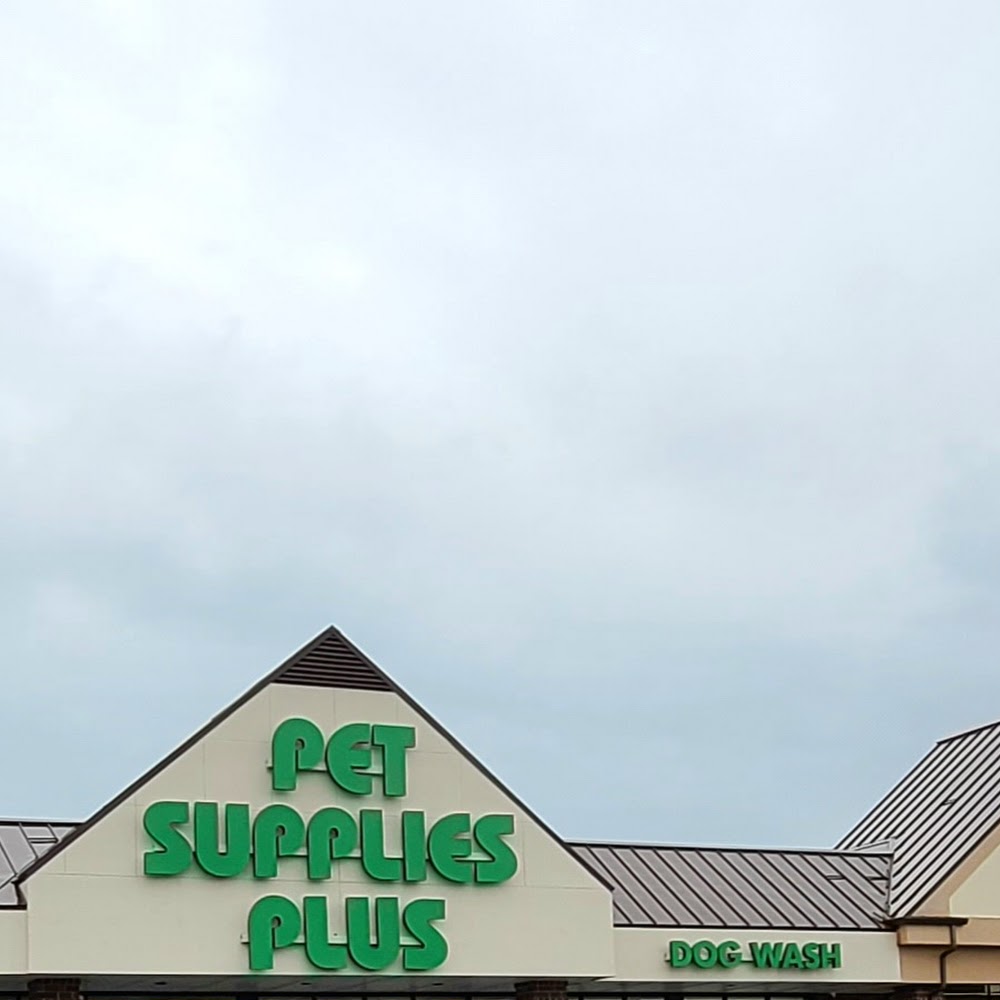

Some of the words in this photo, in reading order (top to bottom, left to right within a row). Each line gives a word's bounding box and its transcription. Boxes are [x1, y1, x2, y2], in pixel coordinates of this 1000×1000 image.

[272, 717, 416, 797] PET
[143, 801, 518, 883] SUPPLIES
[248, 895, 448, 971] PLUS
[669, 940, 743, 968] DOG
[749, 942, 841, 969] WASH
